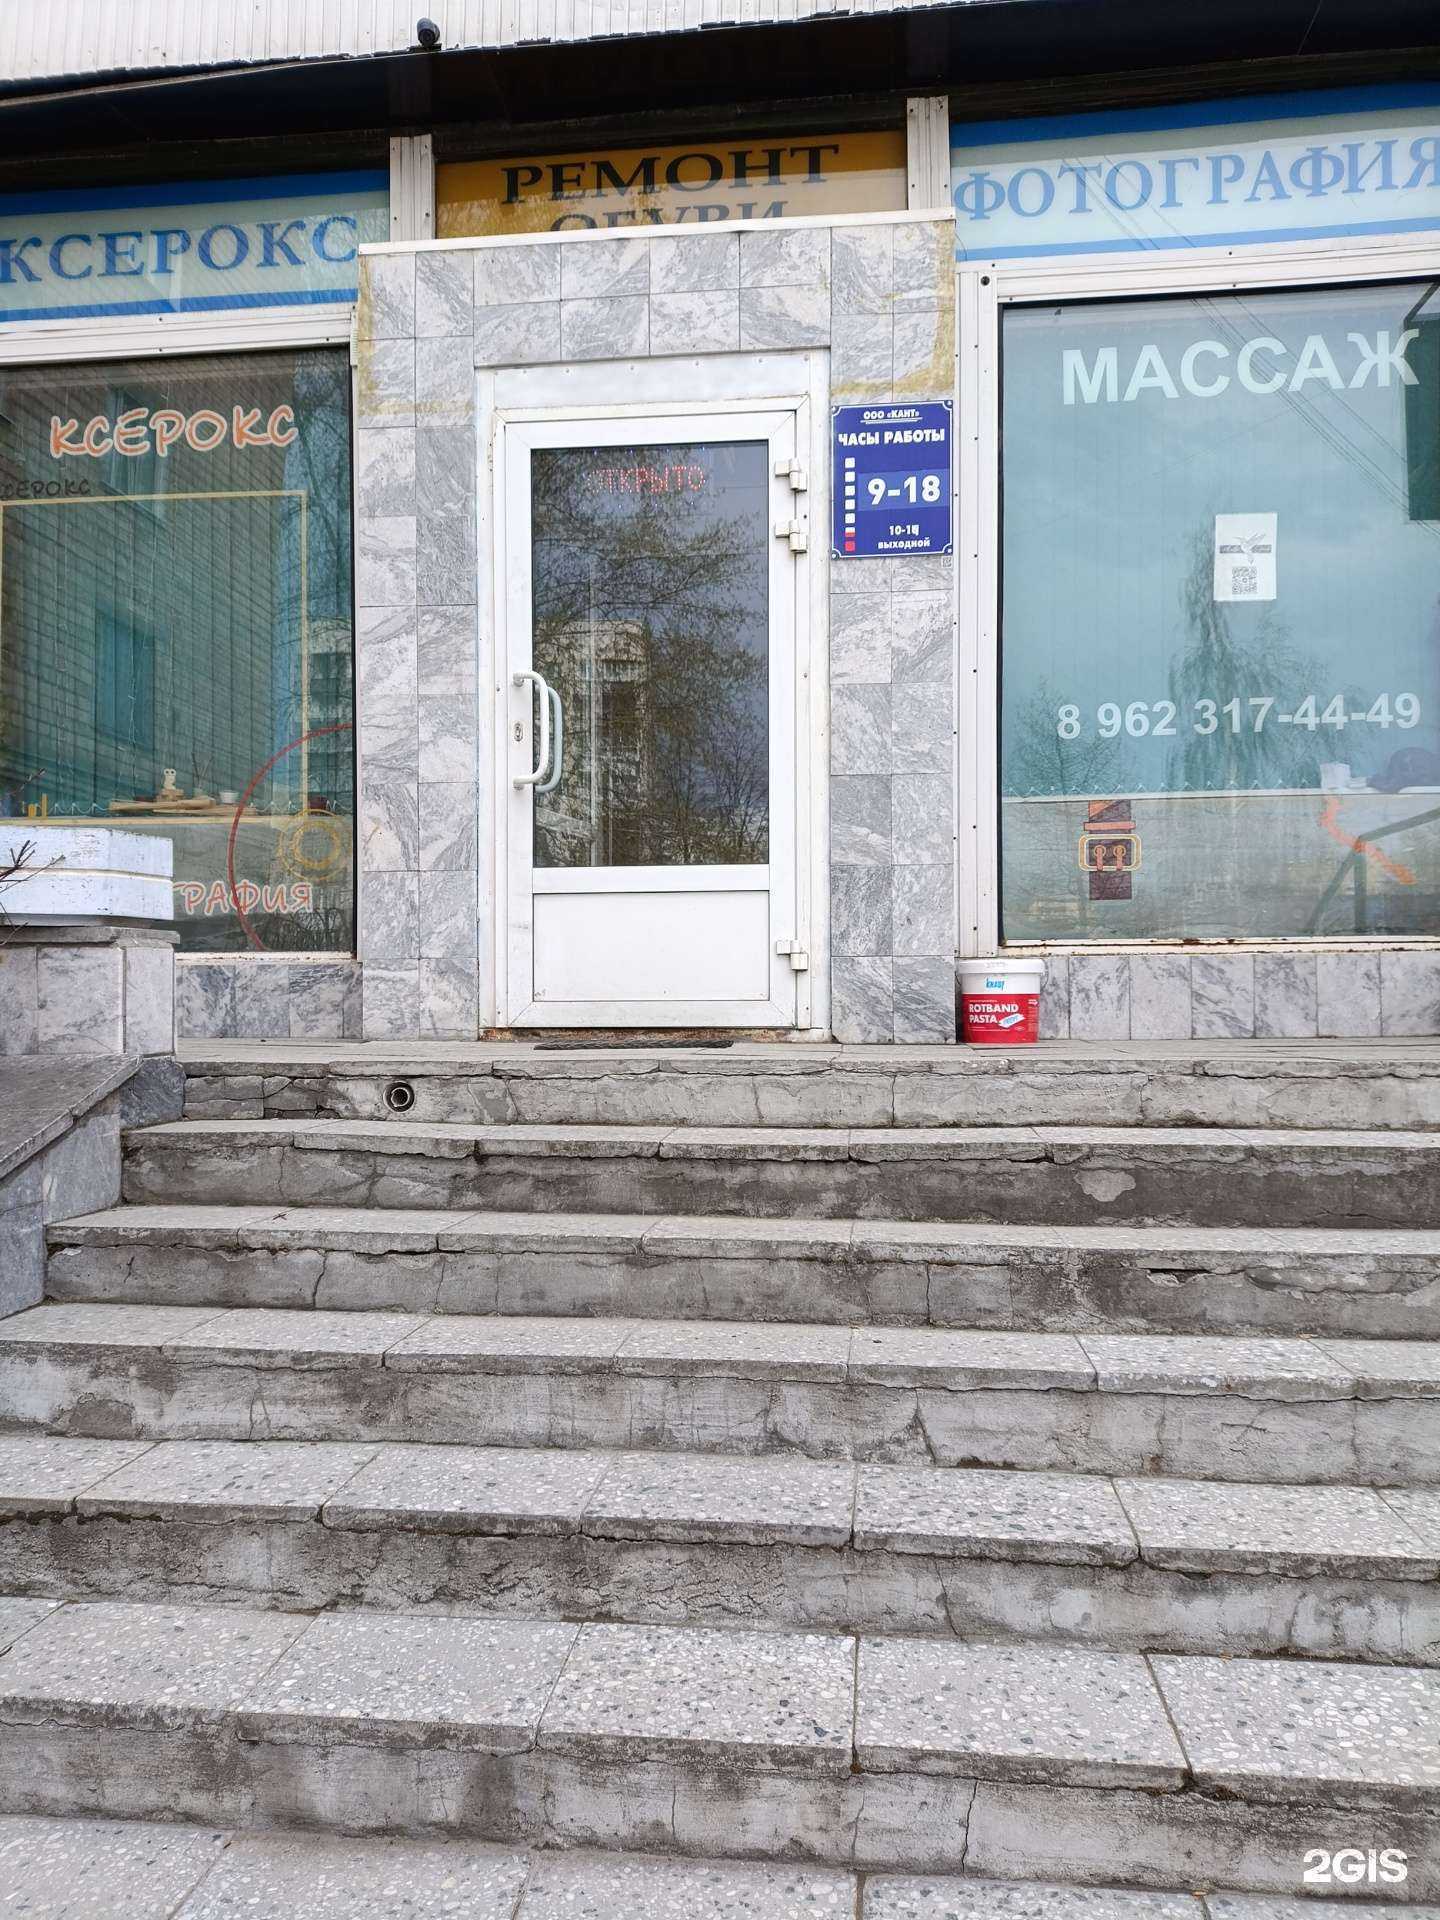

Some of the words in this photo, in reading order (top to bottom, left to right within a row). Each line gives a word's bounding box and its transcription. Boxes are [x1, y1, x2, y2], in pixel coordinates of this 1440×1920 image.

[501, 143, 840, 205] РЕМОНТ
[953, 136, 1440, 220] ФОТОГРАФИЯ
[0, 215, 357, 283] КСЕРОКС
[1062, 328, 1420, 405] МАССАЖ
[49, 405, 299, 459] КСЕРОКС
[863, 411, 885, 420] ООО
[838, 431, 879, 446] ЧАСЫ
[884, 428, 945, 444] РАБОТЫ
[587, 464, 704, 493] ОТКРЫТО
[868, 475, 941, 505] 9-18
[1057, 704, 1081, 739] 8
[1097, 700, 1177, 736] 962
[1193, 692, 1421, 734] 317-44-49
[173, 878, 313, 916] РАФИЯ
[969, 1003, 1019, 1013] ROTBAND
[969, 1014, 998, 1024] PASTA
